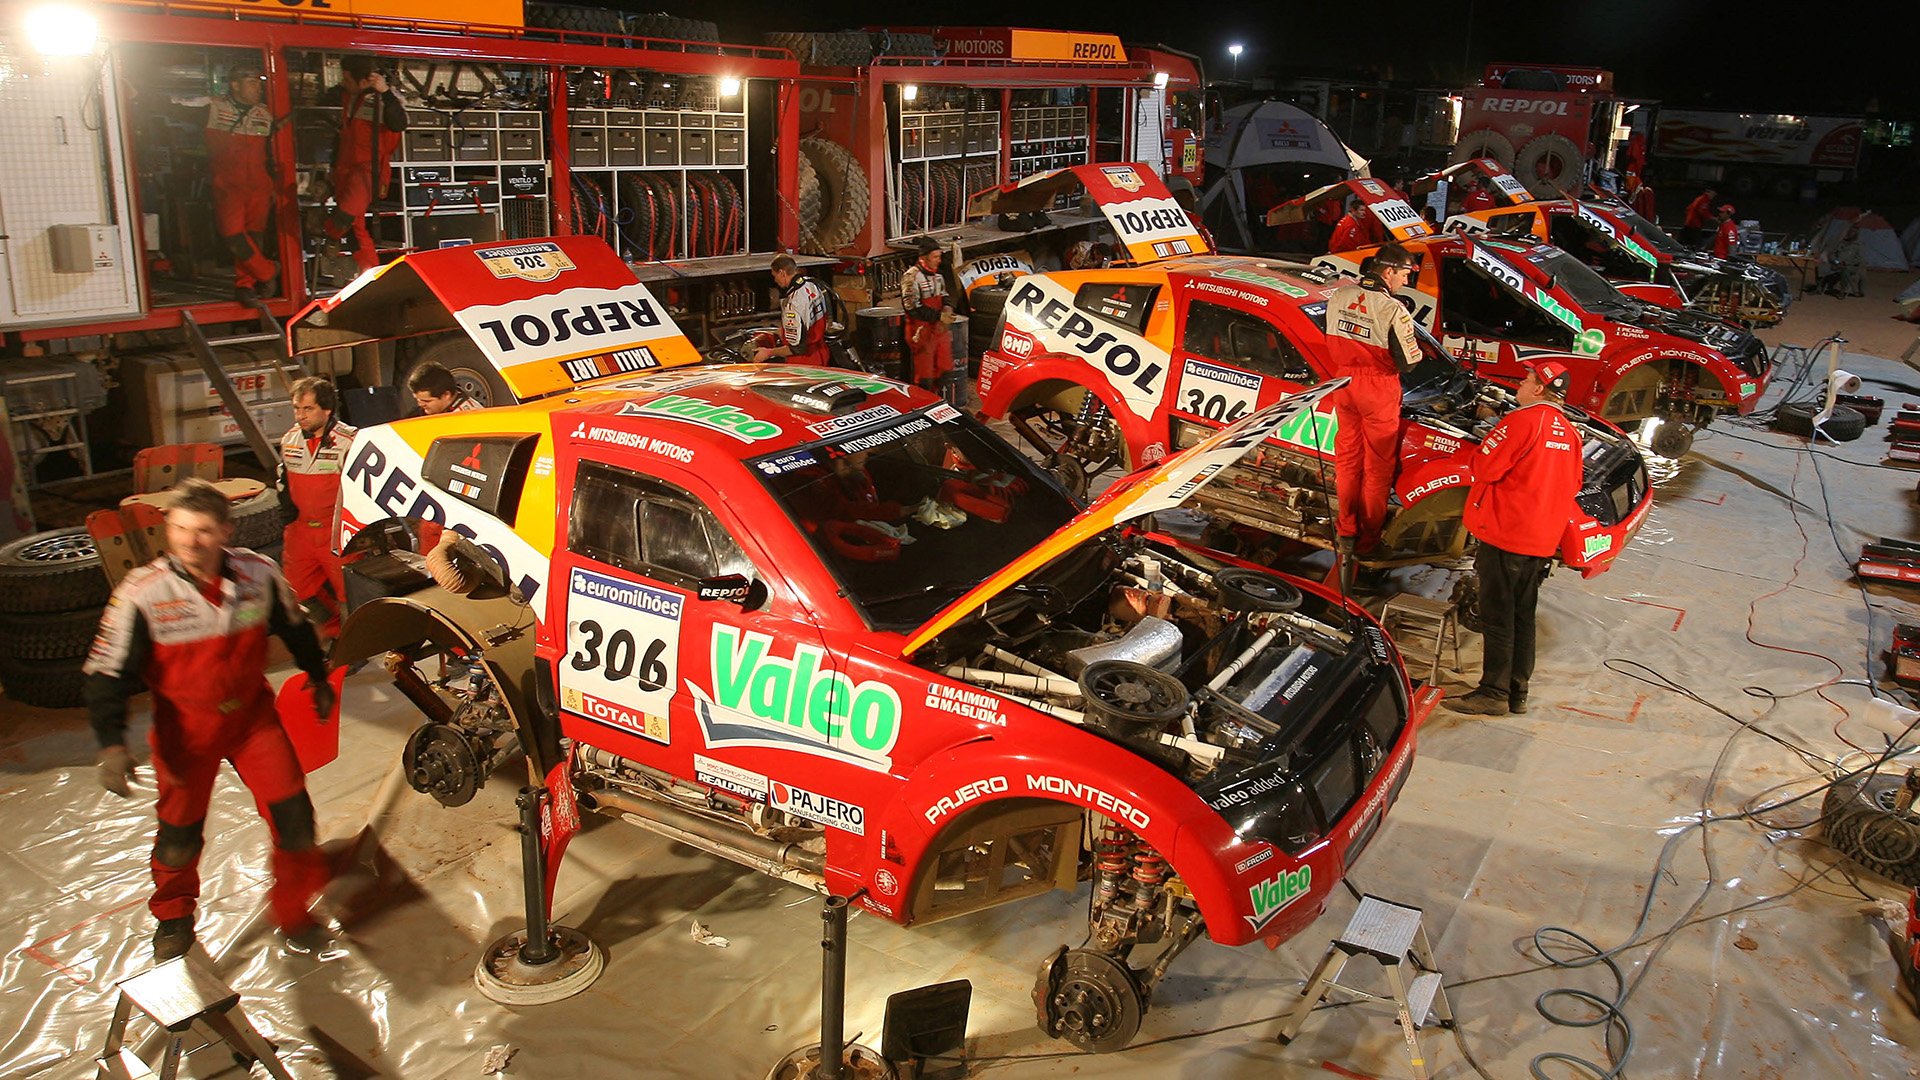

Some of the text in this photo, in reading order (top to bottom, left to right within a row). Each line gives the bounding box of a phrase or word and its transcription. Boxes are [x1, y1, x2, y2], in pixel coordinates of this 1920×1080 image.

[954, 40, 1004, 54] MOTORS
[1073, 43, 1117, 59] REPSOL
[1481, 98, 1568, 115] REPSOL
[1114, 207, 1188, 235] REPSOL
[1378, 206, 1417, 223] REPSOL
[514, 255, 546, 269] 306
[972, 257, 1019, 274] REPSOL
[1301, 272, 1326, 284] REPSOL
[1196, 282, 1269, 306] MITSUBISHI MOTORS
[479, 298, 661, 352] REPSOL
[1010, 282, 1162, 395] REPSOL
[568, 347, 656, 382] RALLI ART
[1616, 350, 1708, 375] PAJERO MONTERO
[1195, 365, 1259, 390] euromilhões
[791, 394, 831, 411] REPSOL
[645, 396, 777, 437] Valeo
[812, 405, 895, 433] BFGoodrich
[588, 427, 694, 463] MITSUBISHI MOTORS
[839, 419, 931, 455] MITSUBISHI MOTORS
[1432, 443, 1457, 454] CRUZ
[1434, 436, 1460, 448] ROMA
[1545, 441, 1570, 451] REPSOL
[777, 455, 795, 465] euro
[782, 458, 817, 472] milhões
[1406, 474, 1460, 502] PAJERO
[1585, 534, 1612, 553] Valeo
[586, 580, 680, 617] euromilhões
[701, 586, 749, 597] REPSOL
[571, 620, 668, 692] 306
[717, 630, 896, 750] Valeo
[941, 686, 1000, 710] MAIMON
[582, 695, 645, 730] TOTAL
[939, 698, 1007, 727] MASUOKA
[698, 773, 767, 801] REALDRIVE
[1209, 772, 1286, 811] valeo added
[791, 788, 863, 825] PAJERO
[924, 774, 1150, 829] PAJERO MONTERO
[789, 806, 838, 827] MANUFACTURING
[1246, 850, 1272, 868] FACOM
[1249, 864, 1311, 916] Valeo
